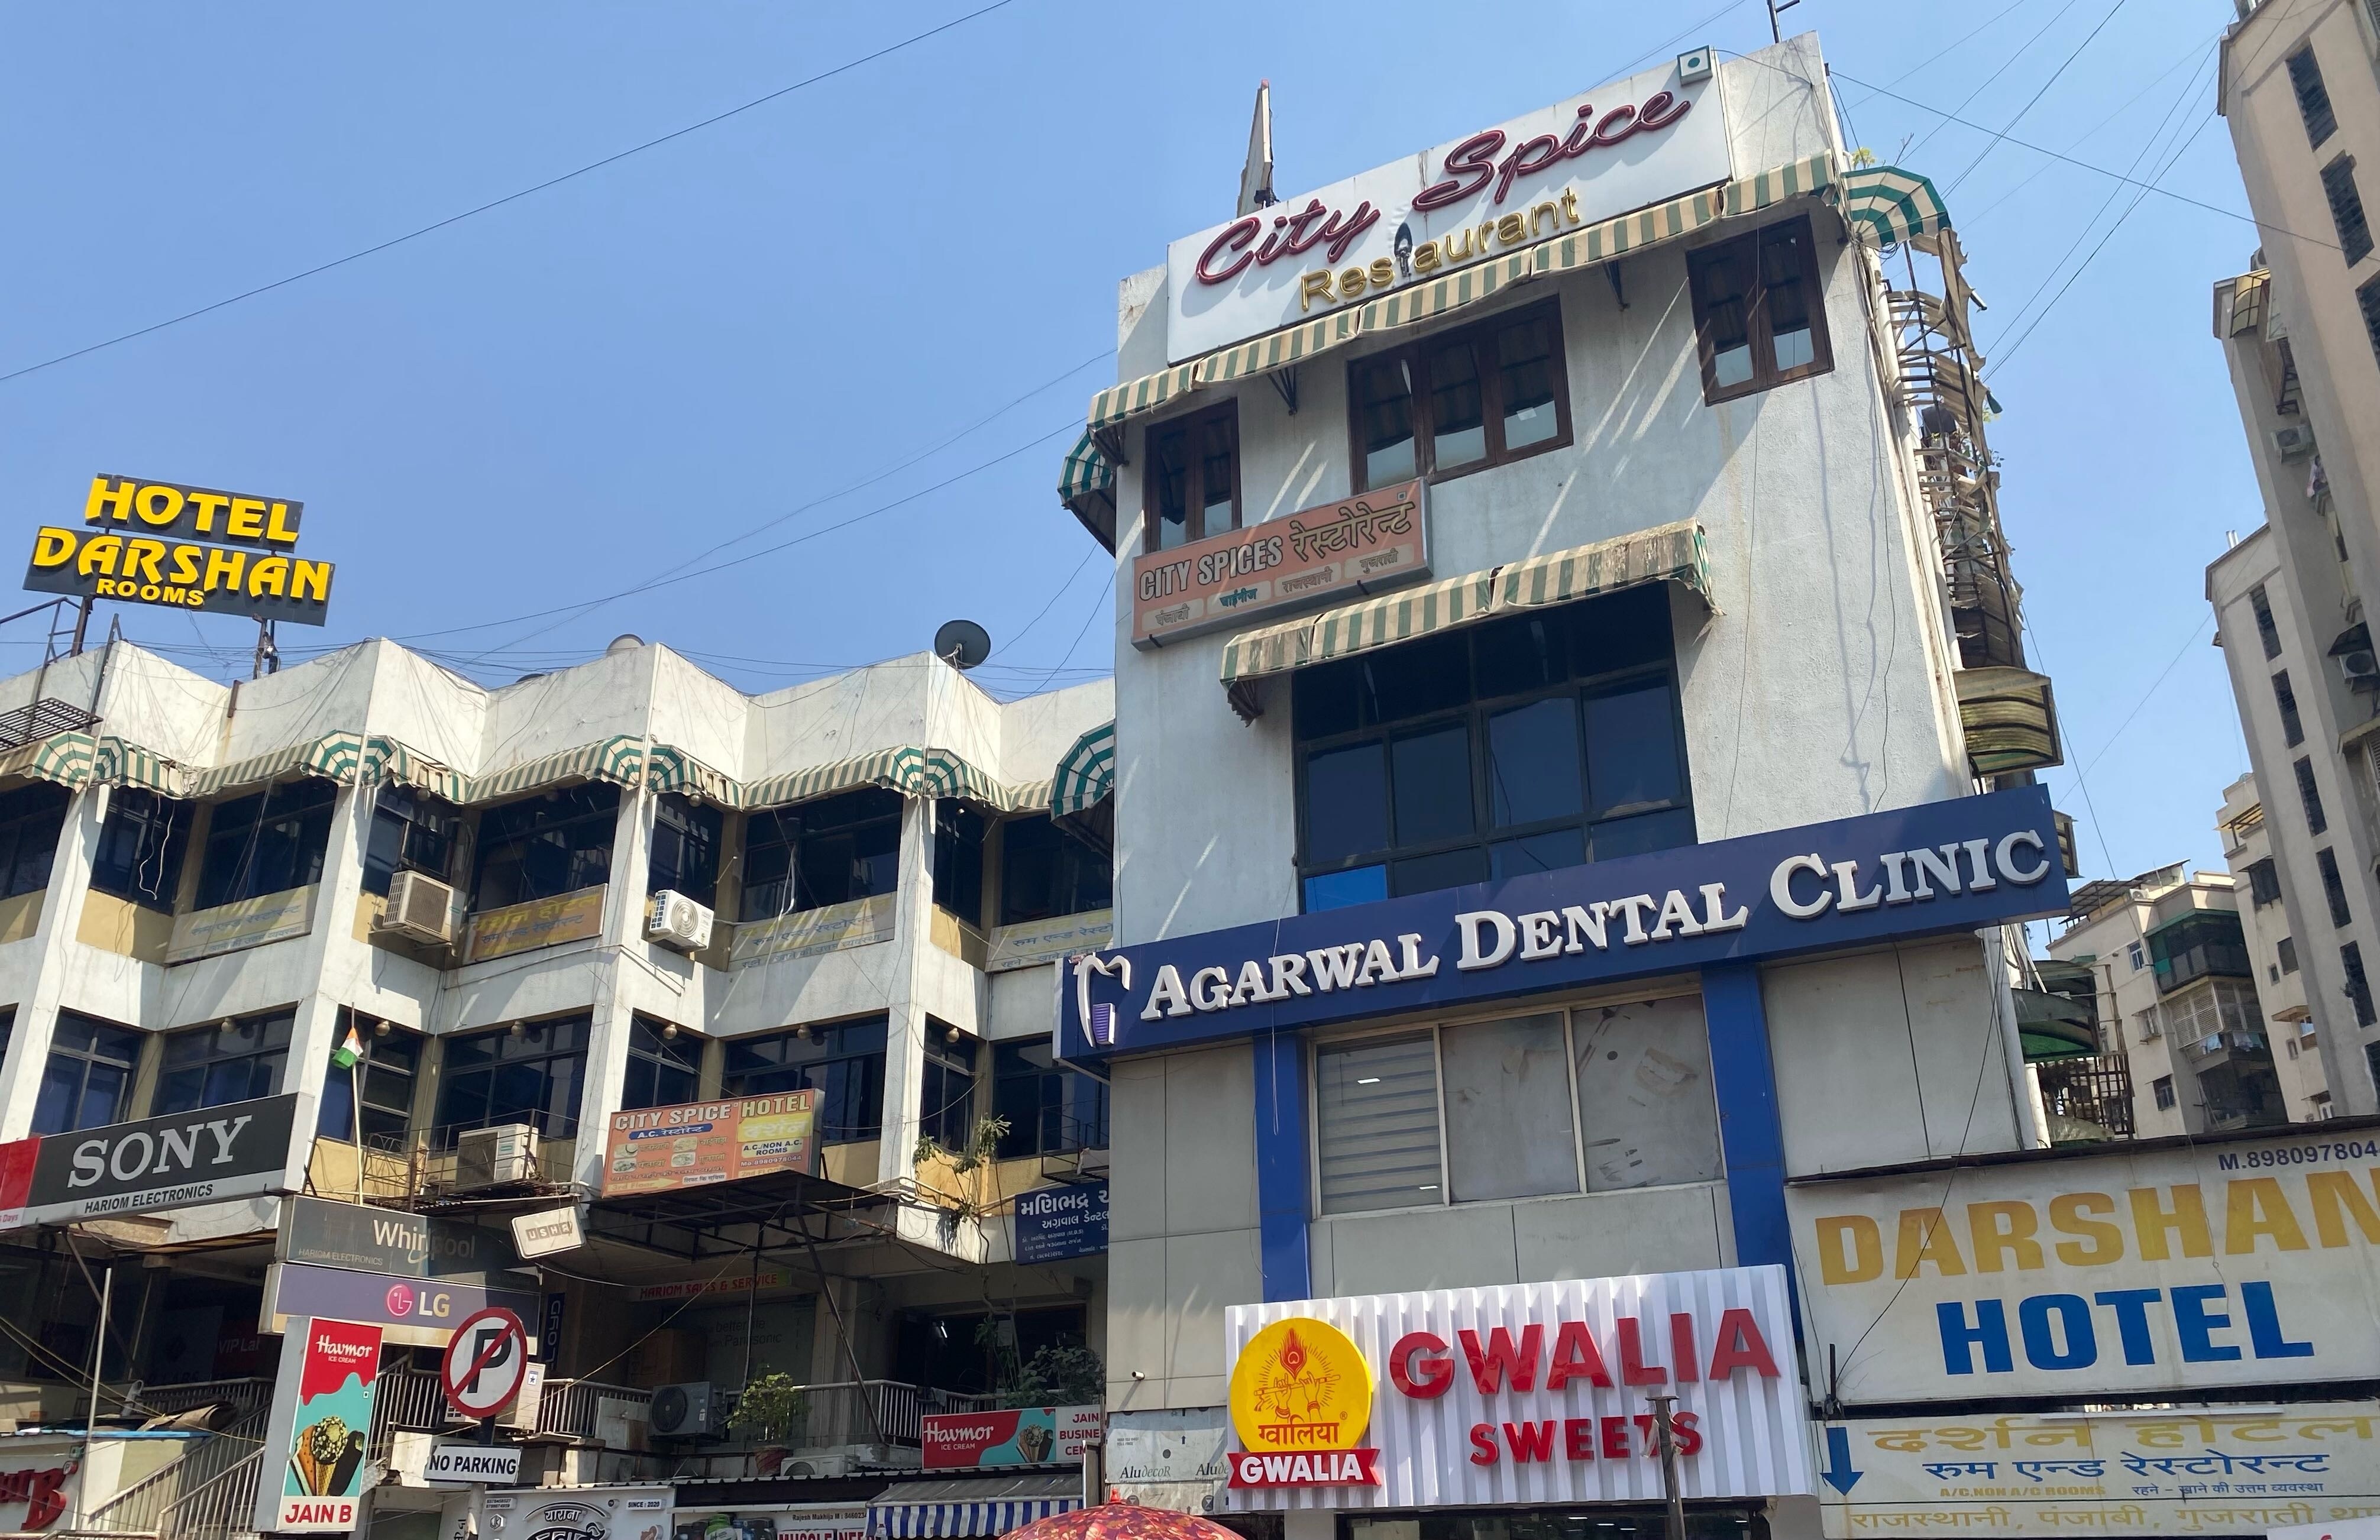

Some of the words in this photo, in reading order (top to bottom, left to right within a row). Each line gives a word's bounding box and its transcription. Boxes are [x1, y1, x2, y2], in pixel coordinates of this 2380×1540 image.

[1195, 198, 1381, 285] City
[1412, 90, 1691, 211] Spice
[85, 477, 299, 542] HOTEL
[33, 526, 331, 602] DARSHAN
[1139, 559, 1192, 601] CITY
[1198, 535, 1283, 585] SPICES
[96, 578, 205, 606] ROOMS
[1079, 923, 1113, 936] रेस्टो
[1140, 933, 1440, 1022] AGARWAL
[1456, 882, 1748, 971] DENTAL
[1770, 830, 2051, 920] CLINIC
[615, 1112, 662, 1131] CITY
[668, 1104, 731, 1125] SPICE
[741, 1094, 811, 1118] HOTEL
[638, 1131, 659, 1139] A.C.
[67, 1115, 253, 1188] SONY
[756, 1147, 788, 1156] ROOMS
[2219, 1140, 2380, 1171] M.898097804
[85, 1195, 130, 1214] HARIOM
[132, 1183, 213, 1206] ELECTRONICS
[528, 1221, 572, 1241] USHA
[1815, 1167, 2380, 1286] DARSHAN
[373, 1219, 476, 1264] Whirlpool
[299, 1248, 331, 1260] HARIOM
[332, 1251, 383, 1266] ELECTRONICS
[419, 1292, 450, 1318] LG
[641, 1285, 682, 1299] HARIOM
[1936, 1280, 2315, 1376] HOTEL
[315, 1334, 373, 1358] Havmor
[1389, 1308, 1781, 1399] GWALIA
[924, 1421, 994, 1444] Havmor
[1072, 1413, 1100, 1423] JAIN
[1258, 1414, 1340, 1445] ग्वालिया
[1059, 1428, 1100, 1441] BUSINE
[1867, 1417, 2099, 1453] दर्शन
[429, 1455, 450, 1471] NO
[454, 1456, 517, 1475] PARKING
[1240, 1454, 1364, 1483] GWALIA
[2011, 1487, 2041, 1497] A/C
[2045, 1486, 2106, 1496] ROOMS
[2132, 1483, 2159, 1496] रहने
[2211, 1481, 2230, 1494] की
[2271, 1483, 2324, 1493] व्यवस्था
[285, 1504, 330, 1524] JAIN
[333, 1505, 351, 1523] B
[2175, 1502, 2315, 1531] गुजराती
